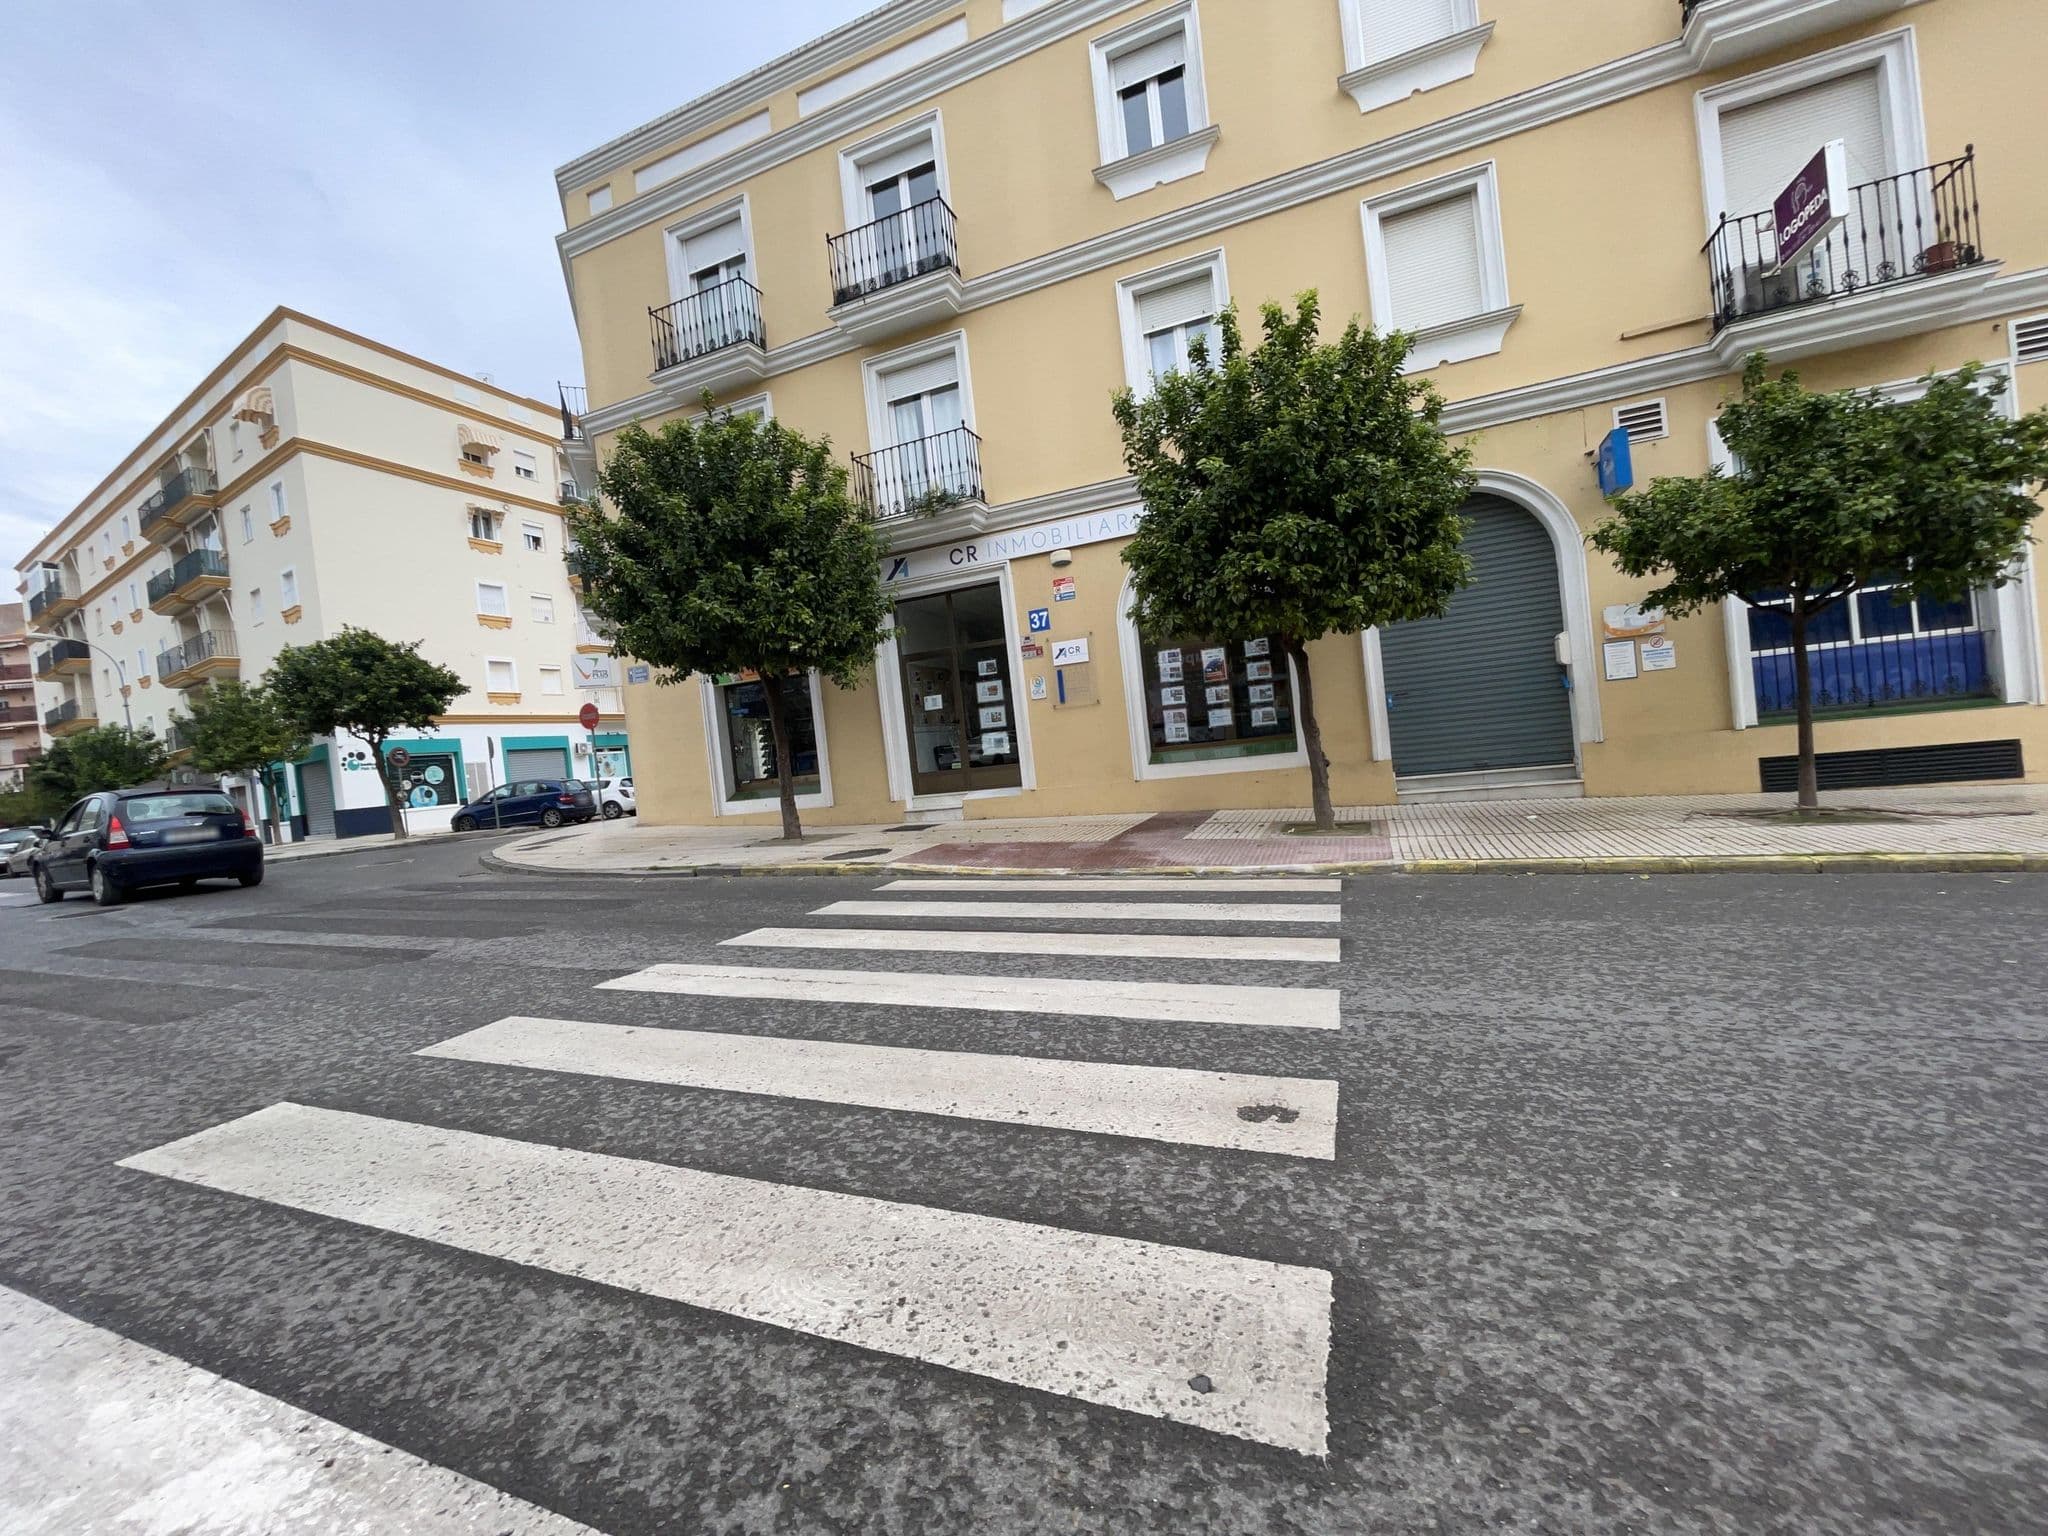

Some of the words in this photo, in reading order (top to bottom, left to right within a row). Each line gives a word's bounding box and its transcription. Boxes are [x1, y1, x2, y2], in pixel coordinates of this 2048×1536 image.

[1779, 188, 1827, 246] LOGOPEDA
[950, 545, 978, 565] CR
[1030, 611, 1048, 629] 37
[1067, 645, 1081, 655] CR
